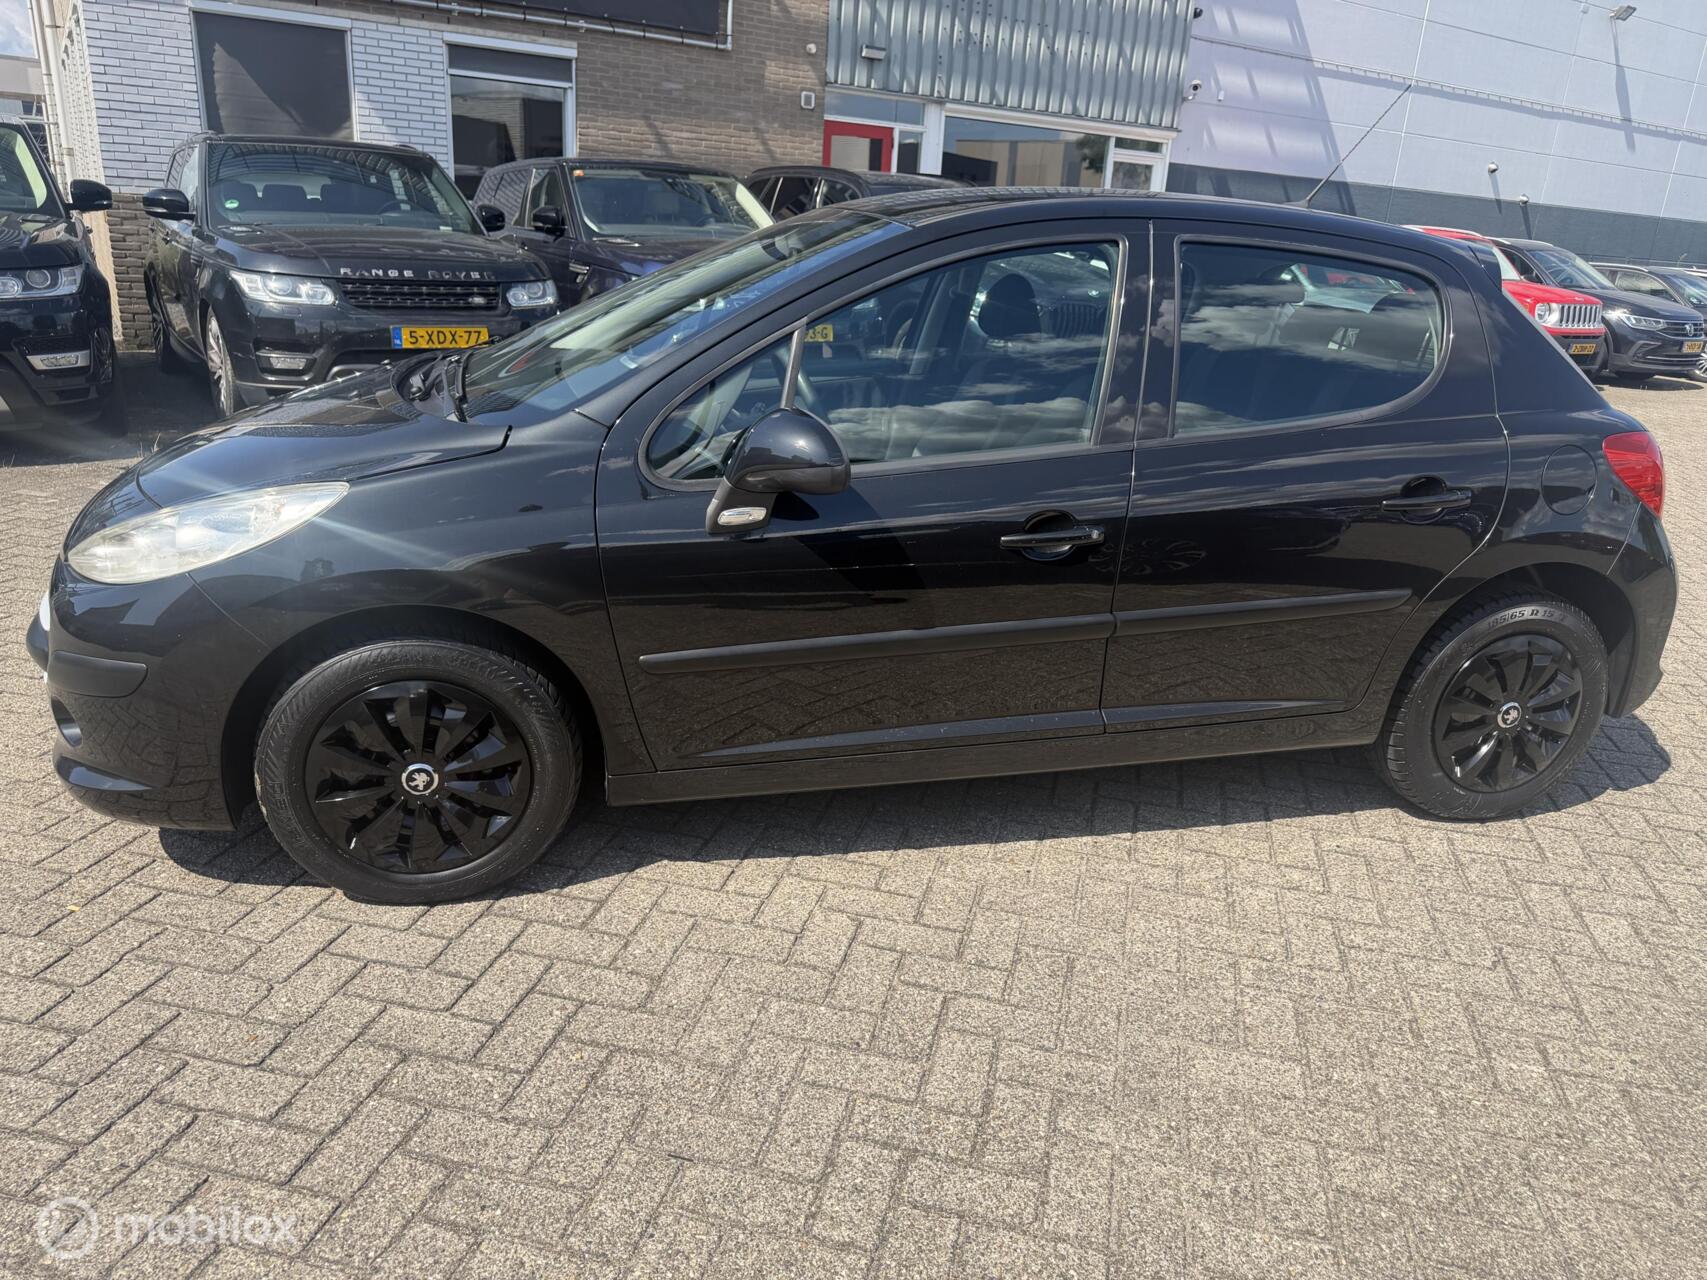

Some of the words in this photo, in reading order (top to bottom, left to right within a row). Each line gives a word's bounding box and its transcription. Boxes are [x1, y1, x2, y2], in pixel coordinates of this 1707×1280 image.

[340, 267, 415, 278] RANGE
[427, 271, 495, 280] ROVER
[409, 330, 482, 345] 5-XDX-77
[804, 326, 829, 340] 3-G
[1529, 608, 1540, 617] R
